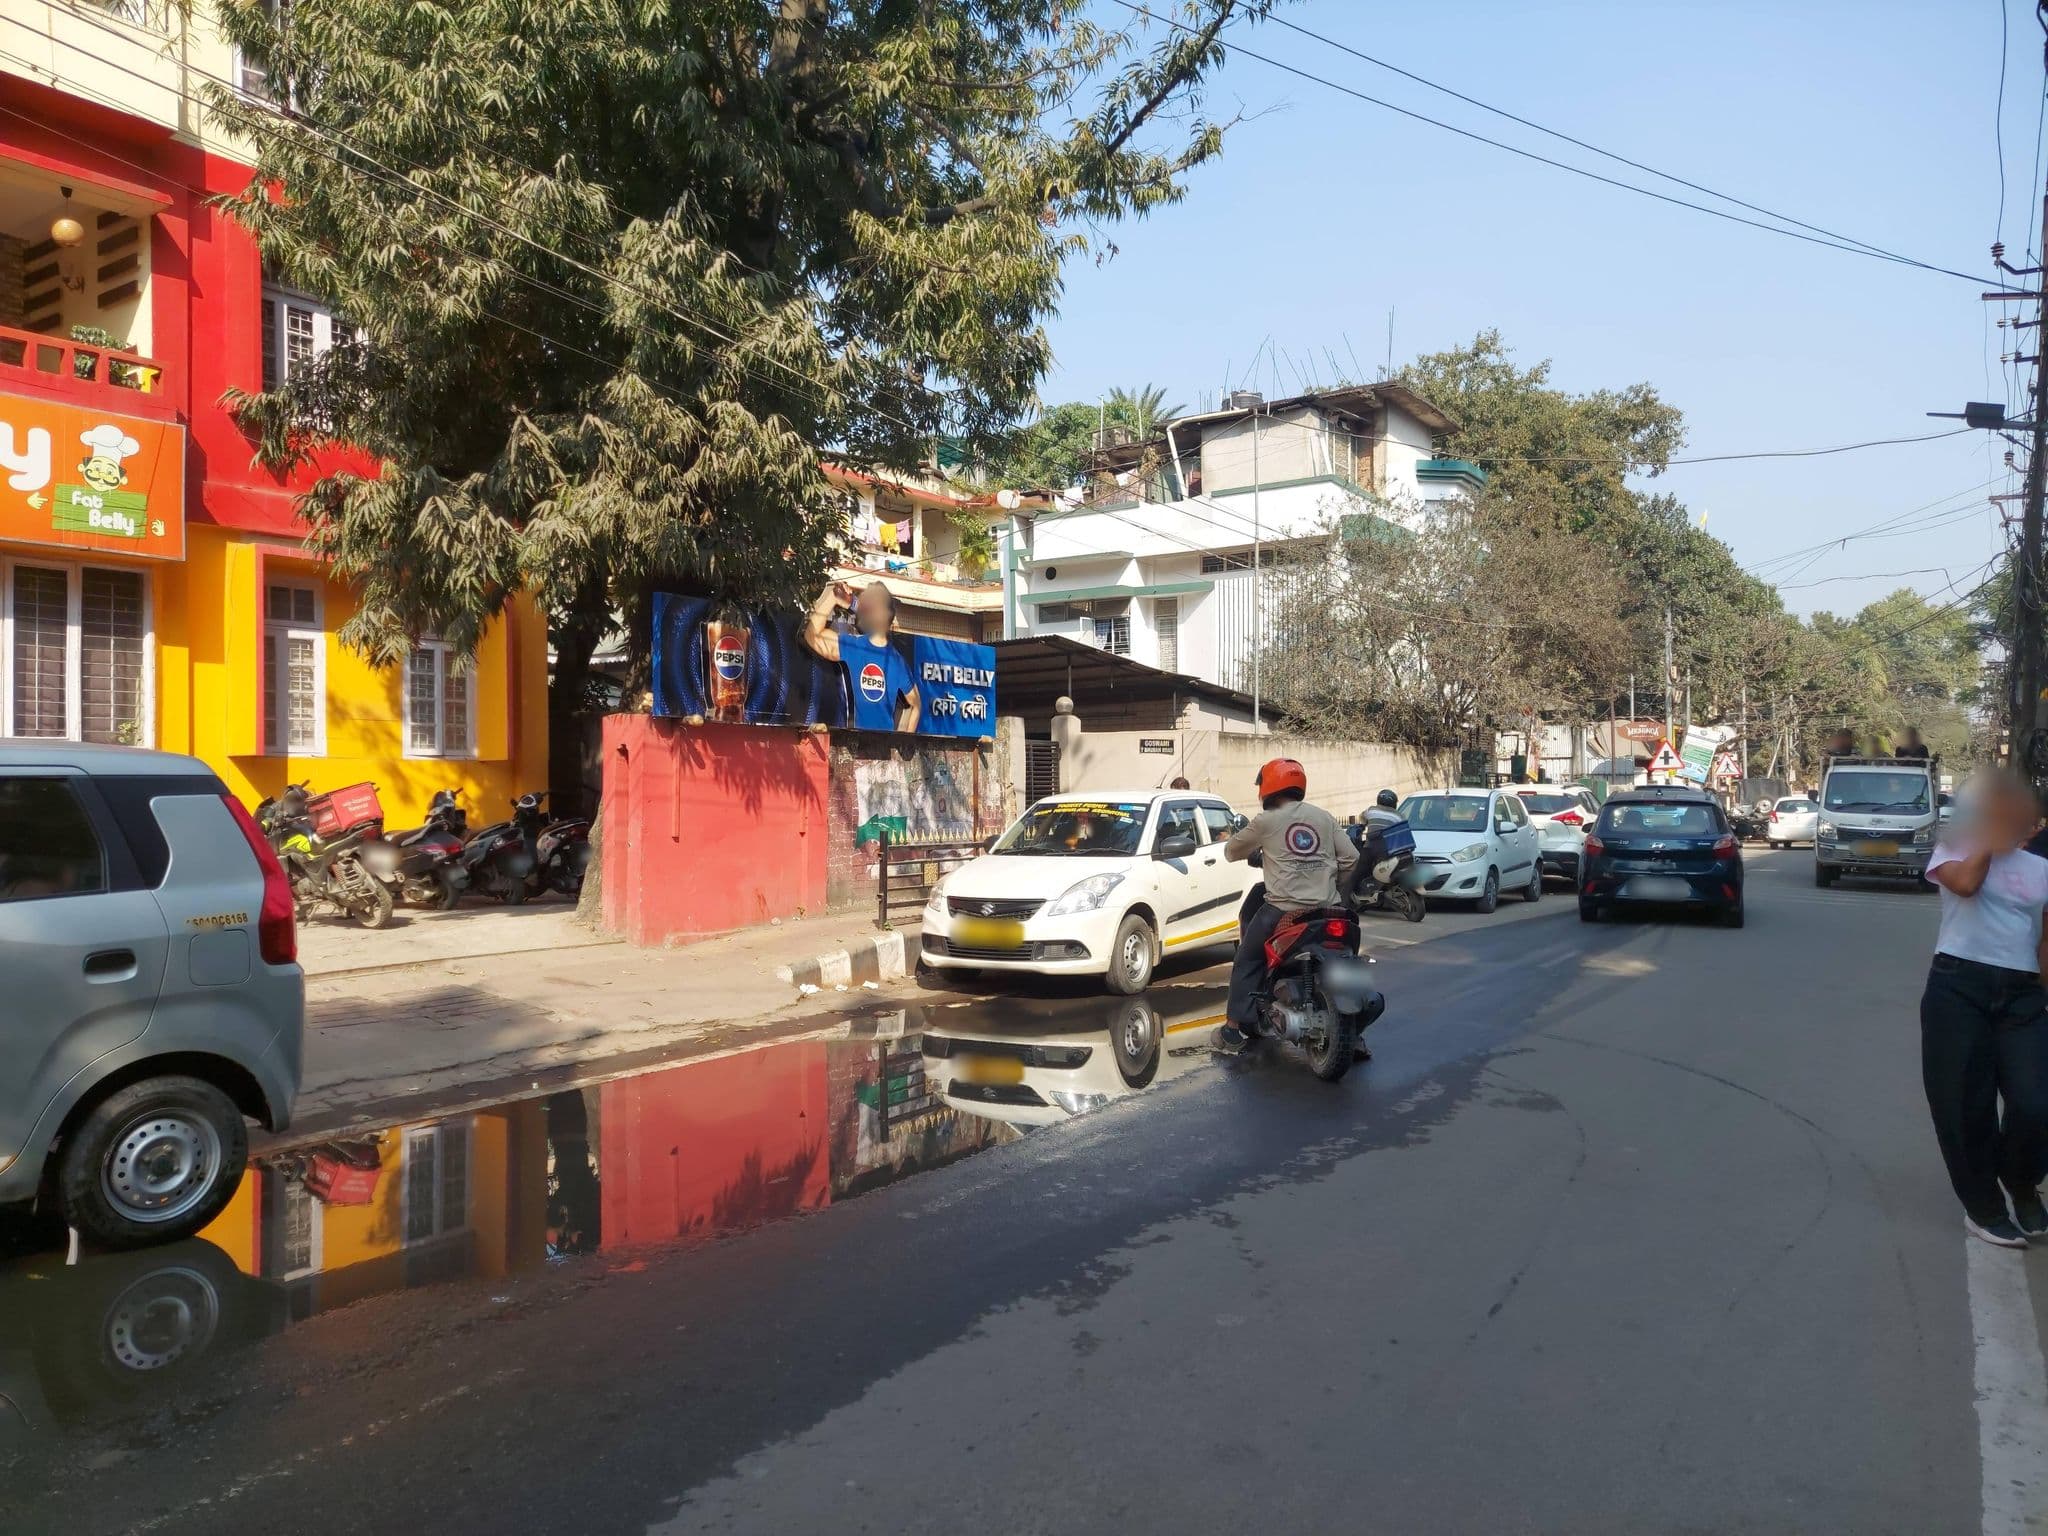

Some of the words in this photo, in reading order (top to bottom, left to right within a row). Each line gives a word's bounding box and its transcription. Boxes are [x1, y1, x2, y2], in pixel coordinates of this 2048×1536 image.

[71, 490, 104, 509] Fat
[88, 508, 135, 536] Belly
[715, 652, 744, 664] PEPSI
[861, 677, 885, 688] PEPSI
[923, 662, 951, 682] FAT
[953, 665, 995, 687] BELLY
[960, 694, 988, 720] বেলী
